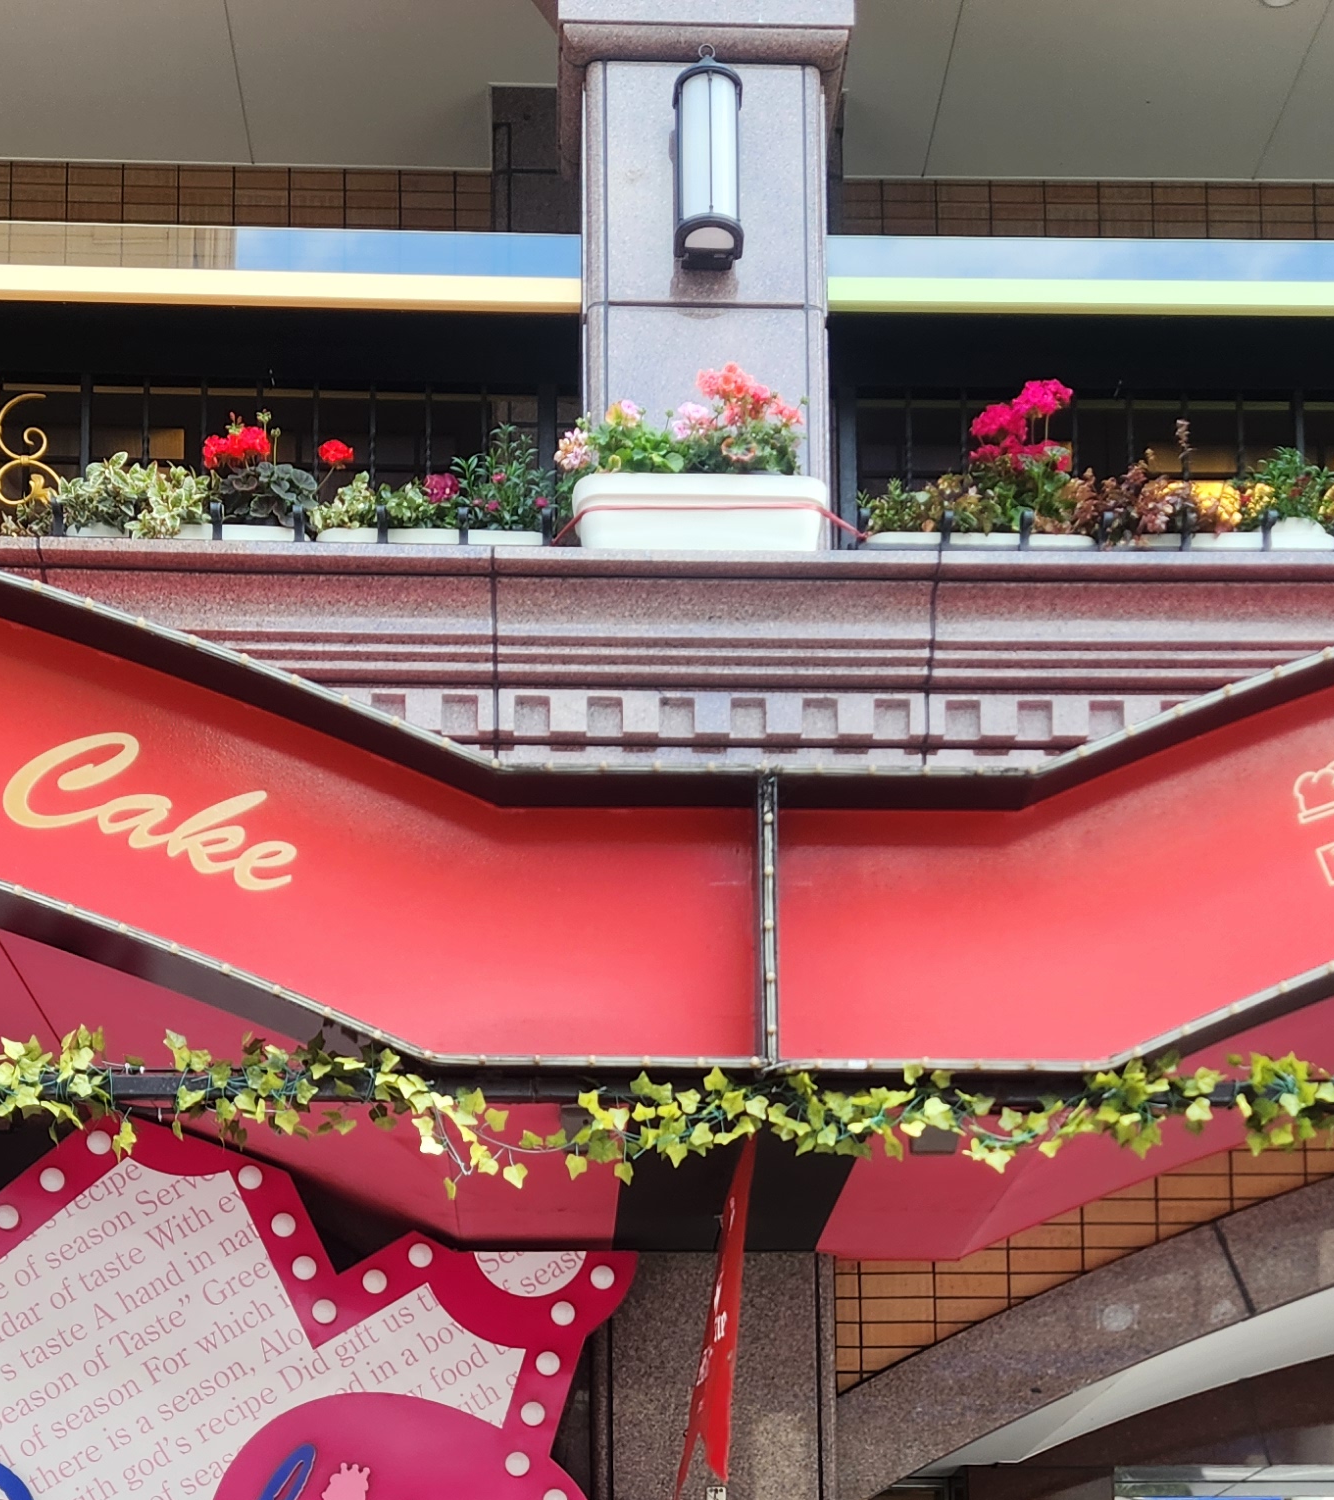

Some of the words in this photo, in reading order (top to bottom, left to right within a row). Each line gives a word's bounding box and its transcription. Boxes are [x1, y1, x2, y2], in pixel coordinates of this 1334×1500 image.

[3, 731, 298, 891] Cake
[14, 1255, 44, 1288] of
[44, 1209, 137, 1271] season
[49, 1276, 78, 1312] of
[78, 1246, 147, 1295] taste
[143, 1203, 215, 1252] With
[19, 1321, 89, 1370] taste
[92, 1302, 117, 1331] A
[115, 1262, 186, 1315] hand
[183, 1251, 217, 1277] in
[82, 1344, 113, 1379] of
[202, 1259, 271, 1308] Gree
[368, 1360, 400, 1387] in
[401, 1348, 421, 1368] a
[428, 1343, 491, 1393] food
[19, 1423, 49, 1458] of
[50, 1378, 144, 1440] season
[140, 1346, 192, 1387] For
[193, 1299, 283, 1355] which
[28, 1443, 104, 1496] there
[102, 1426, 133, 1452] is
[135, 1415, 156, 1435] a
[156, 1359, 257, 1421] season,
[194, 1385, 279, 1444] recipe
[277, 1348, 332, 1395] Did
[333, 1322, 382, 1368] gift
[382, 1305, 416, 1334] us
[460, 1380, 504, 1416] ith
